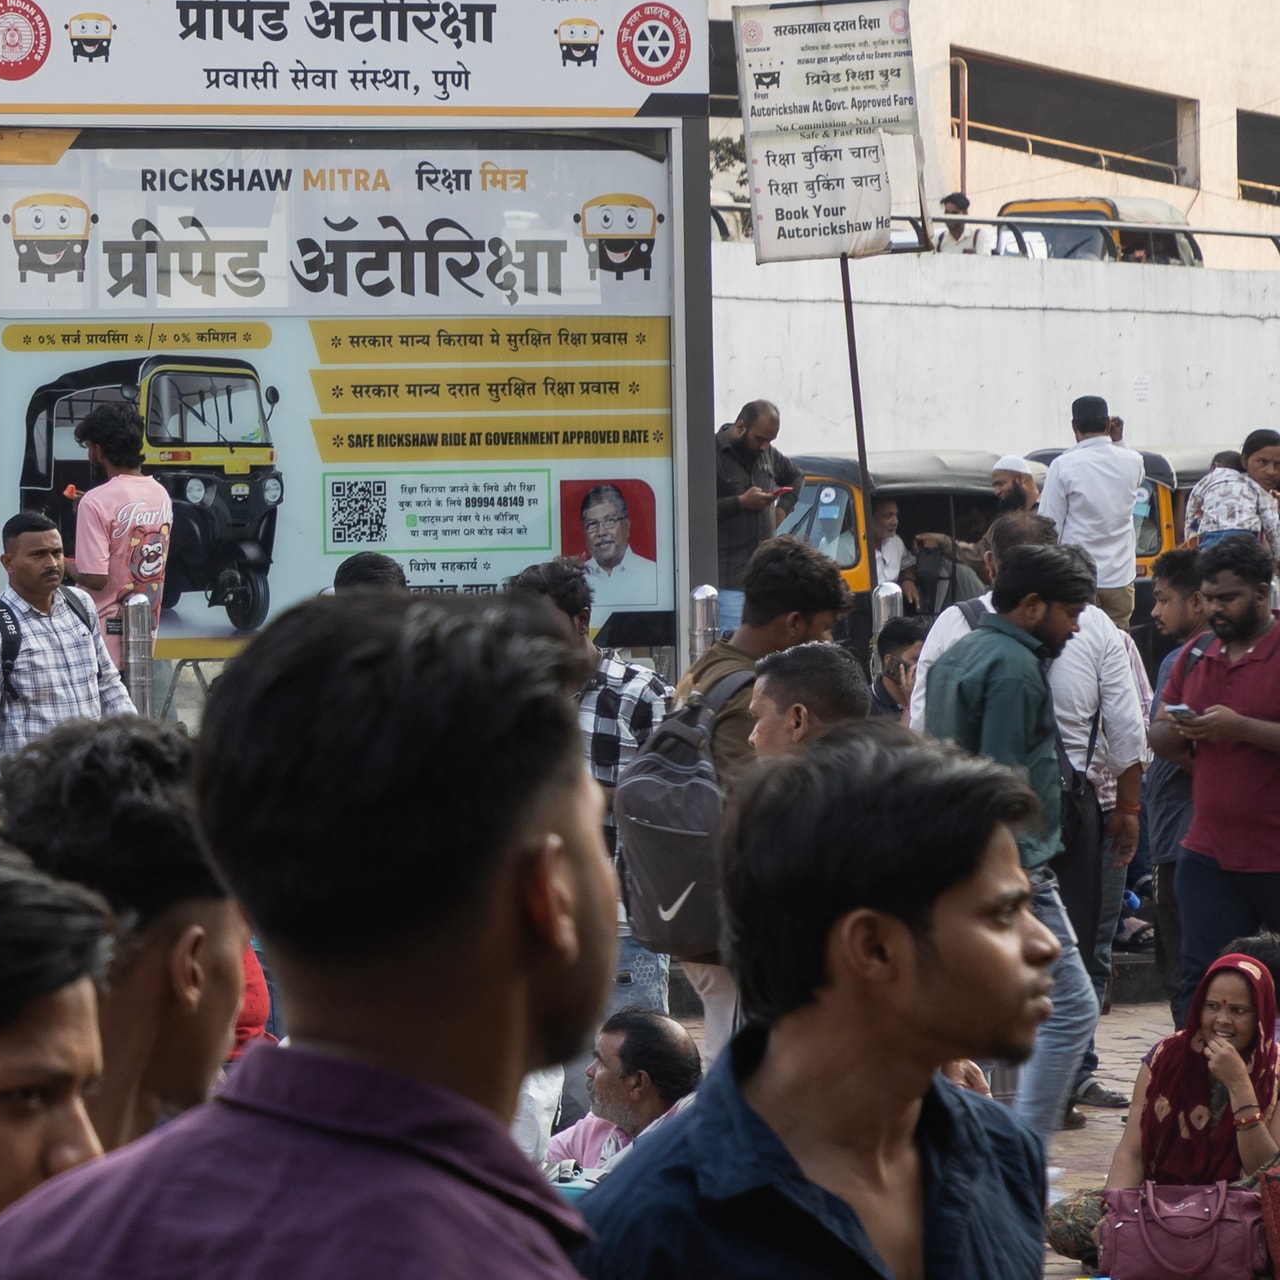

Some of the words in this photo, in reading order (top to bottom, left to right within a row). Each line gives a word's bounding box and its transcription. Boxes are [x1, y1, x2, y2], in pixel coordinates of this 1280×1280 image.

[833, 19, 856, 33] दरात
[858, 14, 881, 31] रिक्षा
[34, 15, 47, 62] RAILWAYS
[622, 47, 632, 68] PUNE
[630, 66, 646, 80] CITY
[646, 73, 674, 83] TRAFFIC
[672, 48, 686, 74] POLICE
[845, 68, 874, 82] रिक्षा
[203, 62, 280, 91] प्रवासी
[291, 60, 337, 91] सेवा
[348, 59, 420, 95] संस्था,
[431, 62, 471, 101] पुणे
[751, 102, 810, 118] Autorickshaw
[813, 100, 823, 113] At
[825, 99, 849, 112] Govt.
[851, 95, 892, 112] Approved
[893, 94, 914, 106] Fare
[775, 124, 789, 133] No
[791, 121, 847, 132] Commission
[856, 117, 869, 126] No
[872, 115, 899, 125] Fraud
[800, 131, 820, 140] Safe
[822, 130, 831, 138] &
[834, 127, 853, 138] Fast
[765, 150, 795, 168] रिक्षा
[801, 145, 843, 169] बुकिंग
[849, 145, 880, 163] चालु
[141, 168, 292, 192] RICKSHAW
[302, 168, 391, 192] MITRA
[415, 161, 472, 195] रिक्षा
[480, 161, 528, 192] मित्र
[768, 179, 798, 196] रिक्षा
[804, 173, 845, 198] बुकिंग
[851, 173, 881, 192] चालु
[775, 206, 810, 221] Book
[812, 204, 846, 218] Your
[777, 220, 872, 240] Autorickshaw
[103, 216, 268, 299] प्रीपेड
[61, 330, 81, 345] सर्ज
[85, 329, 129, 345] प्रायसिंग
[196, 328, 237, 344] कमिशन
[348, 334, 393, 348] सरकार
[398, 334, 431, 347] मान्य
[436, 329, 484, 347] किराया
[506, 328, 552, 352] सुरक्षित
[558, 328, 587, 348] रिक्षा
[591, 332, 629, 346] प्रवास
[351, 384, 399, 399] सरकार
[405, 383, 440, 398] मान्य
[447, 383, 481, 398] दरात
[487, 376, 537, 402] सुरक्षित
[542, 376, 575, 398] रिक्षा
[579, 381, 620, 395] प्रवास
[348, 433, 374, 448] SAFE
[377, 433, 438, 448] RICKSHAW
[441, 432, 467, 447] RIDE
[469, 432, 482, 446] AT
[485, 431, 559, 446] GOVERNMENT
[562, 430, 620, 445] APPROVED
[623, 430, 649, 444] RATE
[465, 497, 495, 508] 89994
[496, 496, 524, 508] 48149
[409, 558, 436, 572] विशेष
[441, 557, 478, 572] सहकार्य
